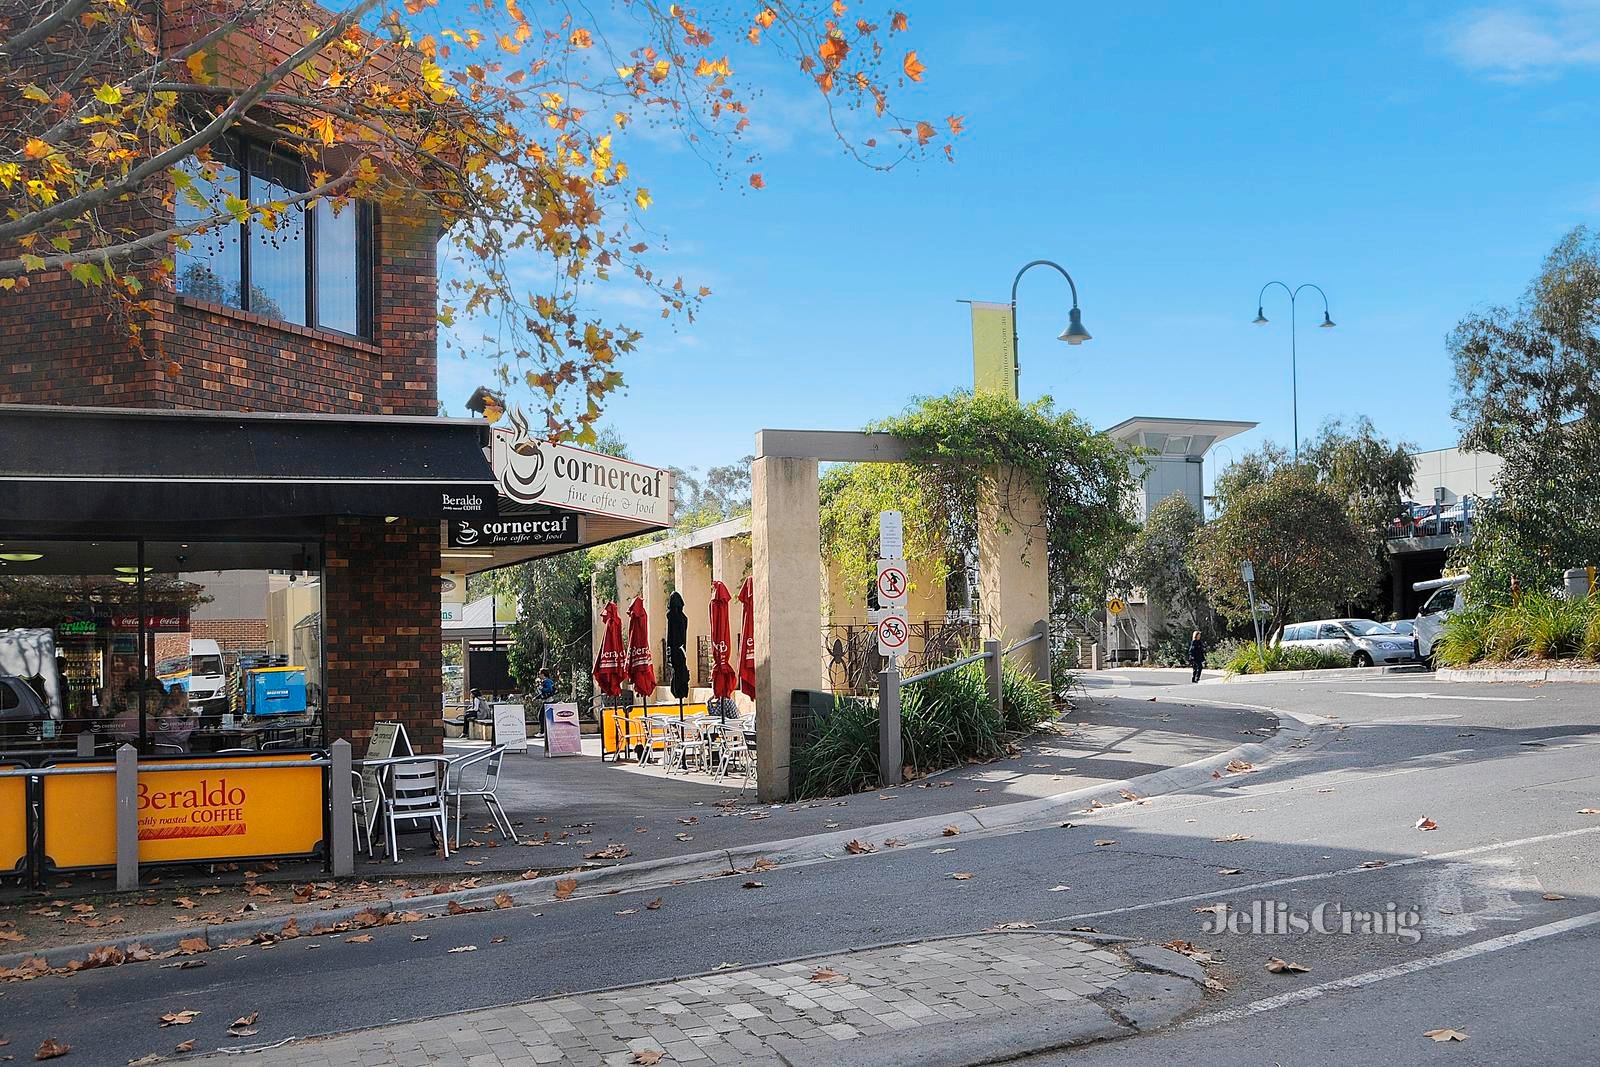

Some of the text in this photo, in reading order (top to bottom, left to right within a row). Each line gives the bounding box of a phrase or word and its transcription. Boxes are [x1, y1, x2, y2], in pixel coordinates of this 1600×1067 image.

[553, 454, 664, 499] cornercaf
[442, 493, 483, 505] Beraldo
[562, 485, 588, 503] fine
[591, 491, 618, 510] coffee
[632, 499, 657, 516] food
[482, 516, 570, 534] cornercaf
[489, 534, 508, 544] fine
[510, 533, 531, 544] coffee
[541, 532, 563, 542] food
[137, 808, 243, 827] eshly roasted COFFEE
